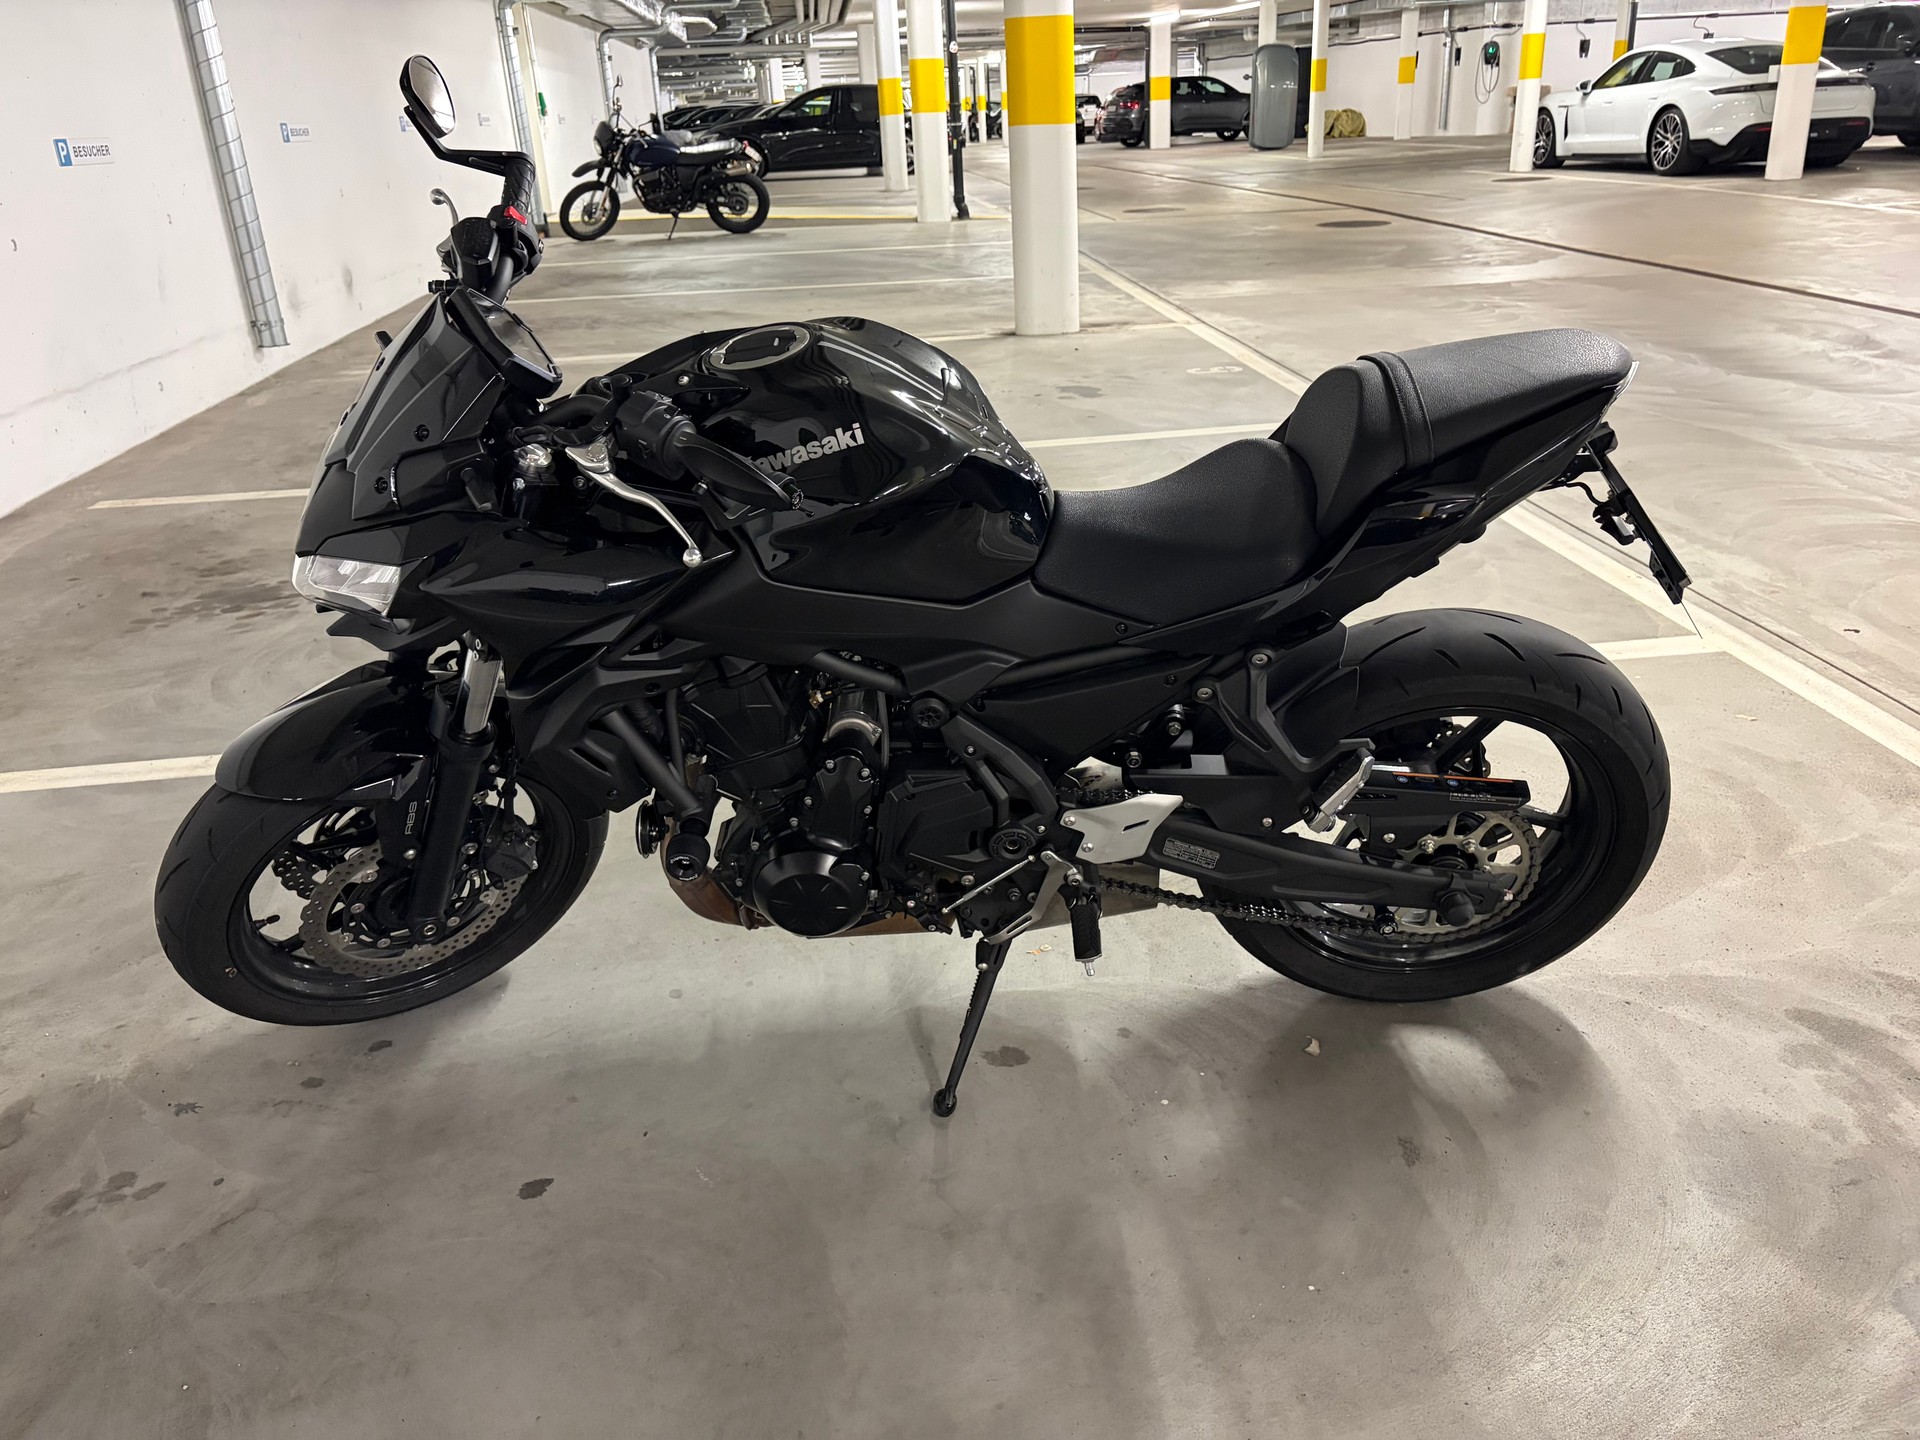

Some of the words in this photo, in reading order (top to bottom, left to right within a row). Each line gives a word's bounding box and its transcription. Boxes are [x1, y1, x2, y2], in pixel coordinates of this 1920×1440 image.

[57, 142, 67, 164] P
[72, 144, 111, 158] BESUCHER
[746, 422, 865, 472] awasaki
[405, 801, 418, 835] ABS
